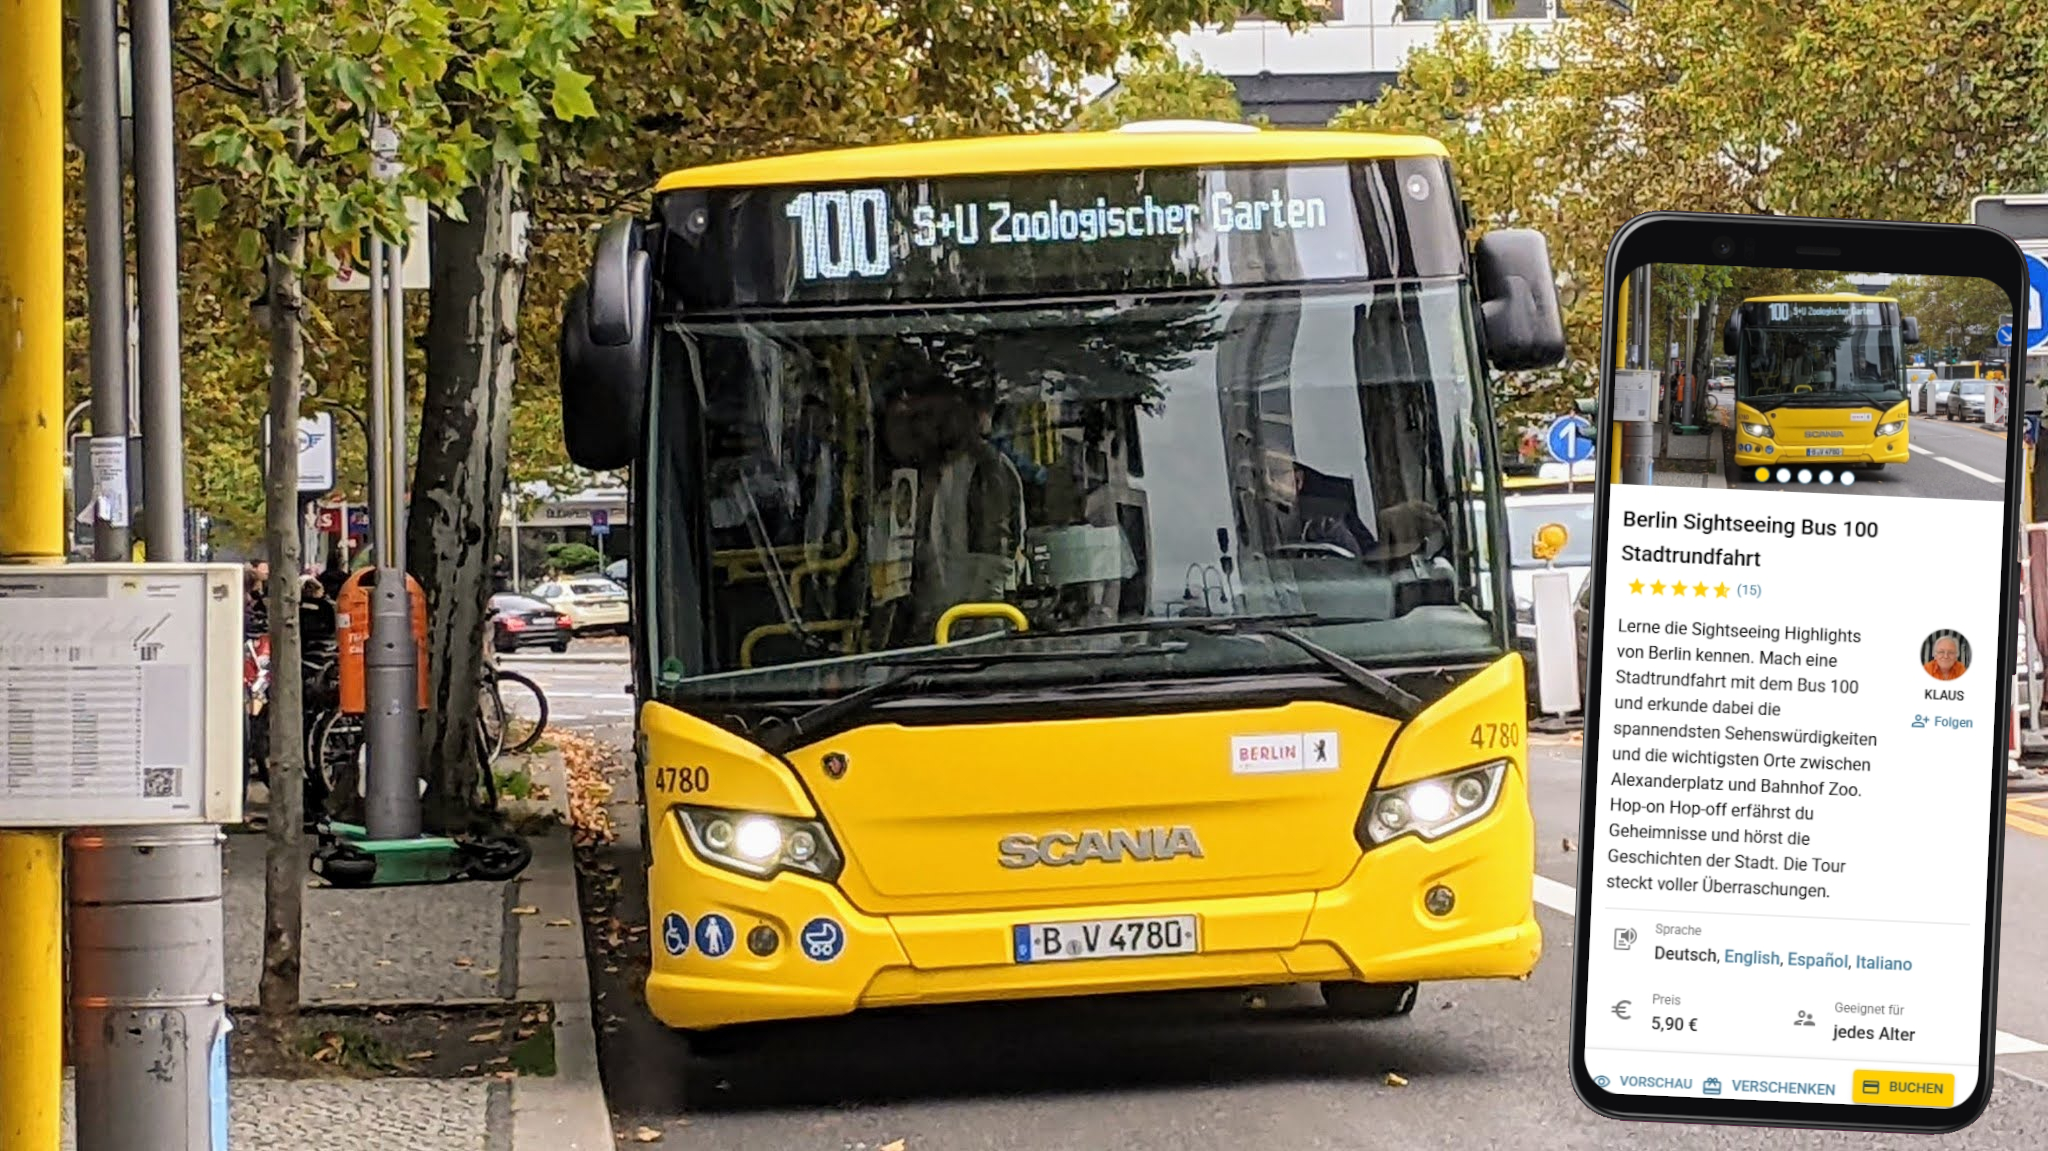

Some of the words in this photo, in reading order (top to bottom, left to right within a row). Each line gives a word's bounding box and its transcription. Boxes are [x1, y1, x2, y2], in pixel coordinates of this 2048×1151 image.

[912, 203, 979, 247] S+U
[988, 195, 1199, 243] Zoologischer
[1211, 188, 1326, 232] Garten
[786, 188, 890, 279] 100
[1769, 303, 1790, 321] 100
[1804, 430, 1844, 439] SCANIA
[1623, 510, 1678, 529] Berlin
[1682, 511, 1795, 539] Sightseeing
[1800, 518, 1837, 536] Bus
[1843, 520, 1879, 538] 100
[1620, 544, 1761, 567] Stadtrundfahrt
[1736, 583, 1762, 598] (15)
[1617, 617, 1661, 634] Lerne
[1664, 620, 1688, 635] die
[1691, 621, 1780, 643] Sightseeing
[1784, 625, 1861, 645] Highlights
[1616, 646, 1644, 659] von
[1648, 644, 1691, 661] Berlin
[1695, 647, 1754, 664] kennen.
[1759, 649, 1801, 666] Mach
[1805, 652, 1838, 668] eine
[1615, 668, 1727, 688] Stadtrundfahrt
[1730, 675, 1755, 690] mit
[1758, 675, 1793, 691] dem
[1797, 676, 1826, 693] Bus
[1830, 678, 1859, 694] 100
[1614, 695, 1643, 710] und
[1646, 696, 1708, 713] erkunde
[1711, 699, 1754, 715] dabei
[1757, 701, 1781, 716] die
[1923, 688, 1965, 701] KLAUS
[1934, 715, 1973, 730] Folgen
[1471, 722, 1519, 750] 4780
[1613, 723, 1721, 739] spannendsten
[1724, 725, 1877, 748] Sehenswürdigkeiten
[1239, 745, 1296, 761] BERLIN
[1611, 746, 1641, 761] und
[1644, 747, 1668, 763] die
[1671, 749, 1759, 769] wichtigsten
[1763, 752, 1796, 768] Orte
[1799, 755, 1871, 772] zwischen
[656, 766, 709, 793] 4780
[1610, 771, 1724, 792] Alexanderplatz
[1727, 777, 1756, 792] und
[1760, 777, 1825, 795] Bahnhof
[1827, 781, 1861, 797] Zoo.
[1609, 796, 1665, 815] Hop-on
[1669, 799, 1728, 818] Hop-off
[1730, 802, 1791, 820] erfährst
[1794, 805, 1814, 821] du
[1608, 822, 1707, 841] Geheimnisse
[1710, 828, 1740, 843] und
[1743, 828, 1783, 845] hörst
[1786, 830, 1810, 846] die
[998, 824, 1204, 869] SCANIA
[1607, 847, 1702, 867] Geschichten
[1705, 852, 1731, 868] der
[1734, 853, 1778, 870] Stadt.
[1783, 855, 1808, 872] Die
[1811, 857, 1847, 873] Tour
[1605, 875, 1653, 890] steckt
[1656, 876, 1699, 892] voller
[1702, 875, 1830, 900] Überraschungen.
[1042, 927, 1062, 955] B
[1082, 924, 1101, 952] V
[1109, 921, 1182, 951] 4780
[1655, 923, 1702, 936] Sprache
[1654, 945, 1720, 964] Deutsch,
[1724, 948, 1784, 967] English,
[1787, 951, 1852, 970] Español,
[1855, 954, 1913, 971] Italiano
[1652, 993, 1681, 1005] Preis
[1834, 1001, 1885, 1016] Geeignet
[1888, 1004, 1904, 1015] für
[1651, 1015, 1684, 1032] 5,90
[1688, 1017, 1698, 1032] €
[1831, 1023, 1875, 1041] jedes
[1877, 1026, 1916, 1042] Alter
[1619, 1075, 1693, 1089] VORSCHAU
[1731, 1079, 1836, 1096] VERSCHENKEN
[1889, 1080, 1945, 1095] BUCHEN
